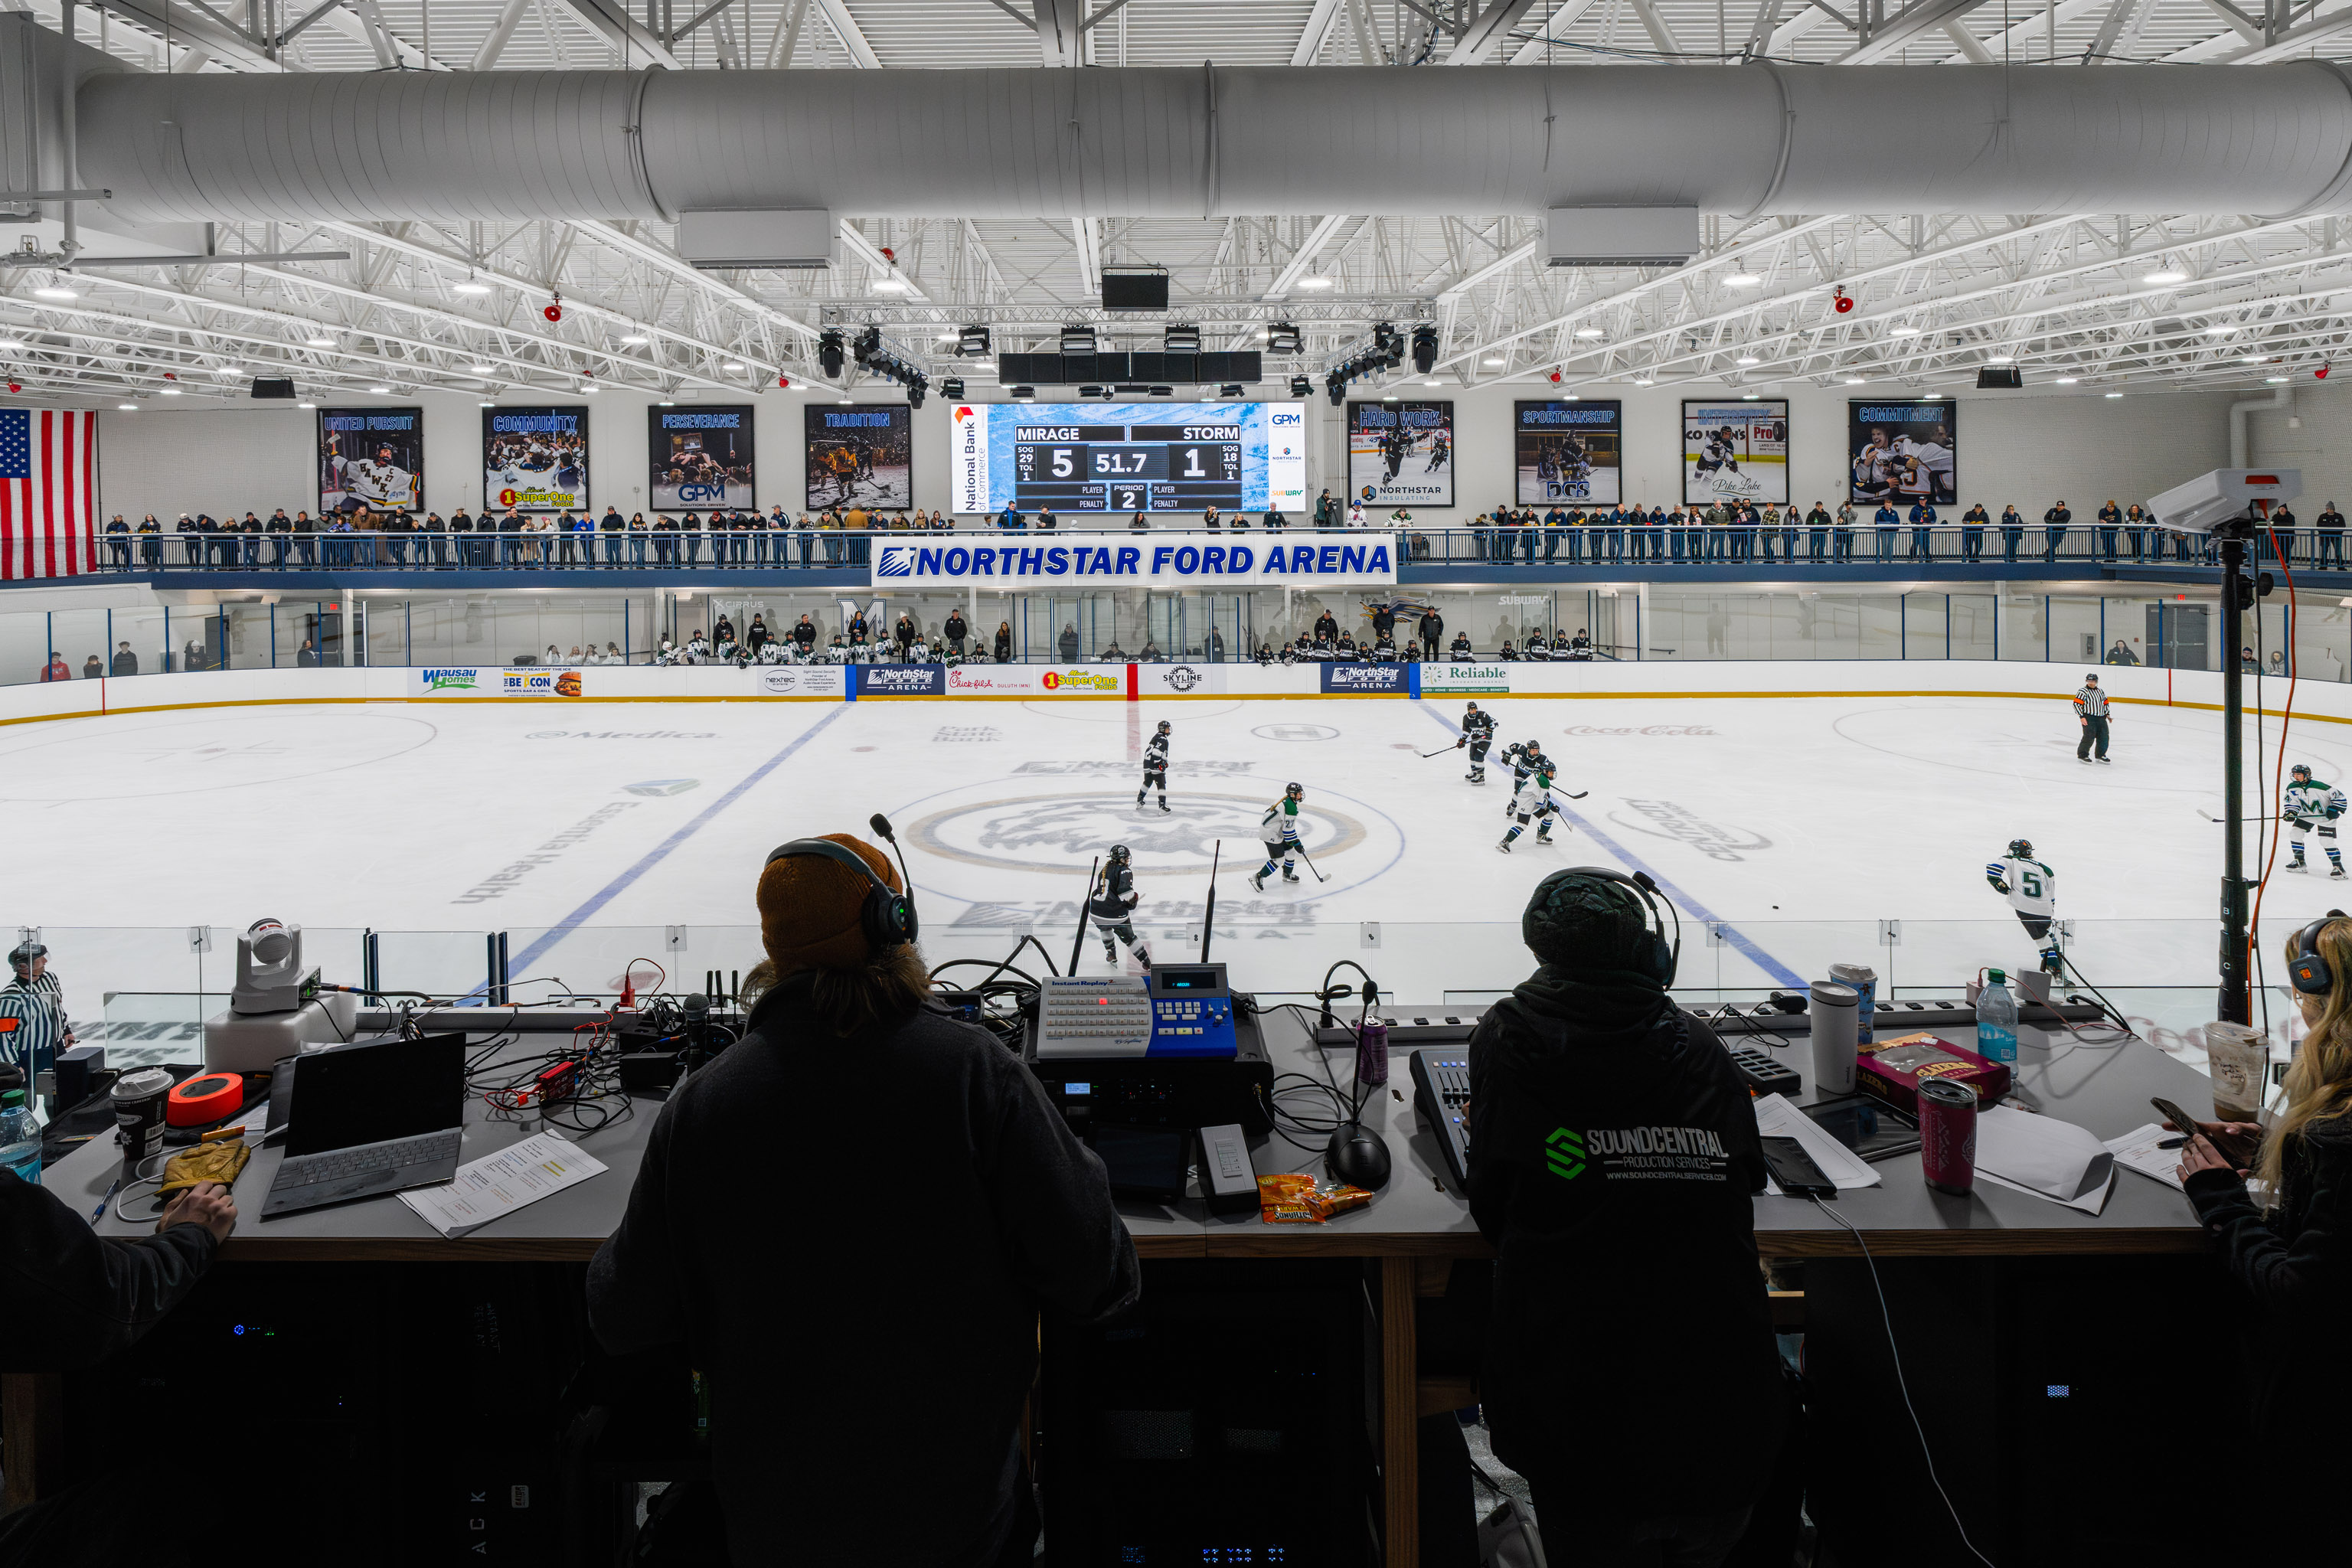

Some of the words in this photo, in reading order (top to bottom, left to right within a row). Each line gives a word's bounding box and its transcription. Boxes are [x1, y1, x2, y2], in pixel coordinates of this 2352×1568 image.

[662, 413, 740, 429] PERSEVERANCE
[825, 413, 890, 427] TRADITION
[1272, 414, 1300, 425] GPM
[1361, 411, 1397, 426] HARD
[1400, 411, 1440, 426] WORK
[1523, 410, 1615, 423] SPORTMANSHIP
[1697, 409, 1770, 425] INTEGRITY
[1860, 407, 1945, 422] COMMITMENT
[325, 416, 364, 430] UNITED
[367, 416, 413, 430] PURSUIT
[493, 416, 577, 431] COMMUNITY
[964, 422, 975, 454] Bank
[1018, 428, 1080, 440] MIRAGE
[1183, 426, 1239, 440] STORM
[1019, 454, 1033, 463] 29
[1051, 449, 1073, 477] 5
[1096, 453, 1147, 473] 51.7
[1184, 449, 1206, 477] 1
[1223, 453, 1237, 462] 18
[977, 448, 986, 504] Commerce
[1023, 472, 1031, 481] 1
[1227, 472, 1235, 480] 1
[965, 457, 975, 511] National
[1082, 486, 1103, 495] PLAYER
[1154, 485, 1175, 494] PLAYER
[1547, 481, 1590, 498] DCS
[1712, 479, 1737, 492] Pike
[1738, 478, 1762, 494] Lake
[514, 491, 575, 504] SuperOne
[678, 484, 725, 502] GPM
[1122, 492, 1135, 508] 2
[1080, 500, 1103, 508] PENALTY
[1154, 499, 1178, 508] PENALTY
[914, 545, 1140, 577] NORTHSTAR
[1151, 545, 1254, 576] FORD
[1261, 544, 1391, 575] ARENA
[1498, 596, 1549, 605] SUBWAY
[423, 668, 477, 684] Wausau
[884, 668, 934, 678] NorthStar
[1348, 667, 1399, 677] NorthStar
[1449, 667, 1506, 678] Reliable
[432, 676, 475, 690] Homes
[1057, 675, 1118, 687] SuperOne
[1563, 724, 1720, 736] Coca-Cola
[2298, 798, 2325, 815] M
[2022, 871, 2043, 899] 5
[2223, 906, 2230, 915] B
[2223, 961, 2231, 970] C
[1586, 1126, 1729, 1158] SOUNDCENTRAL
[1623, 1156, 1675, 1168] PRODUCTION
[1676, 1157, 1710, 1169] SERVICES
[1606, 1171, 1726, 1181] WWW.SOUNDCENTRALSERVICES.COM
